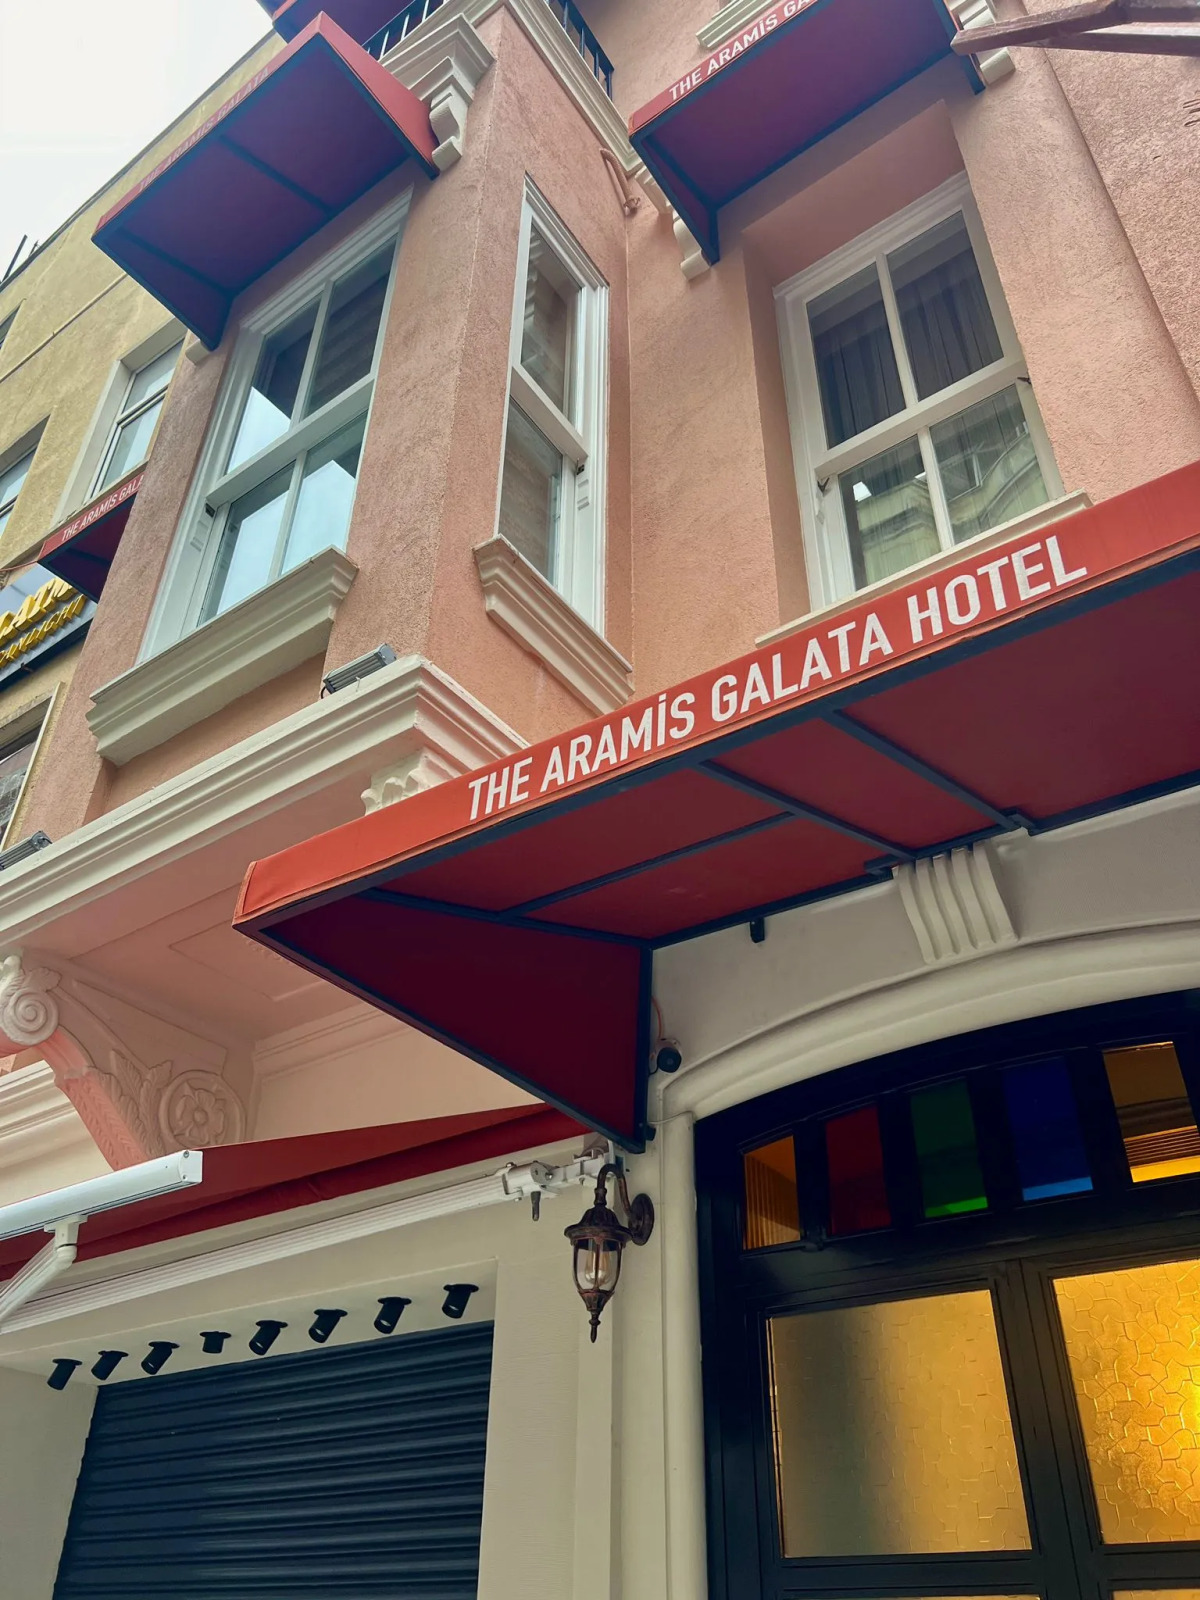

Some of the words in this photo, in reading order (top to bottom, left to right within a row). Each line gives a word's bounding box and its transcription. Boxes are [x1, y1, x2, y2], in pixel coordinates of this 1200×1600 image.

[669, 68, 702, 100] THE
[62, 521, 80, 541] THE
[468, 757, 533, 821] THE
[540, 693, 696, 793] ARAMİS
[711, 613, 894, 722] GALATA
[906, 536, 1088, 644] HOTEL
